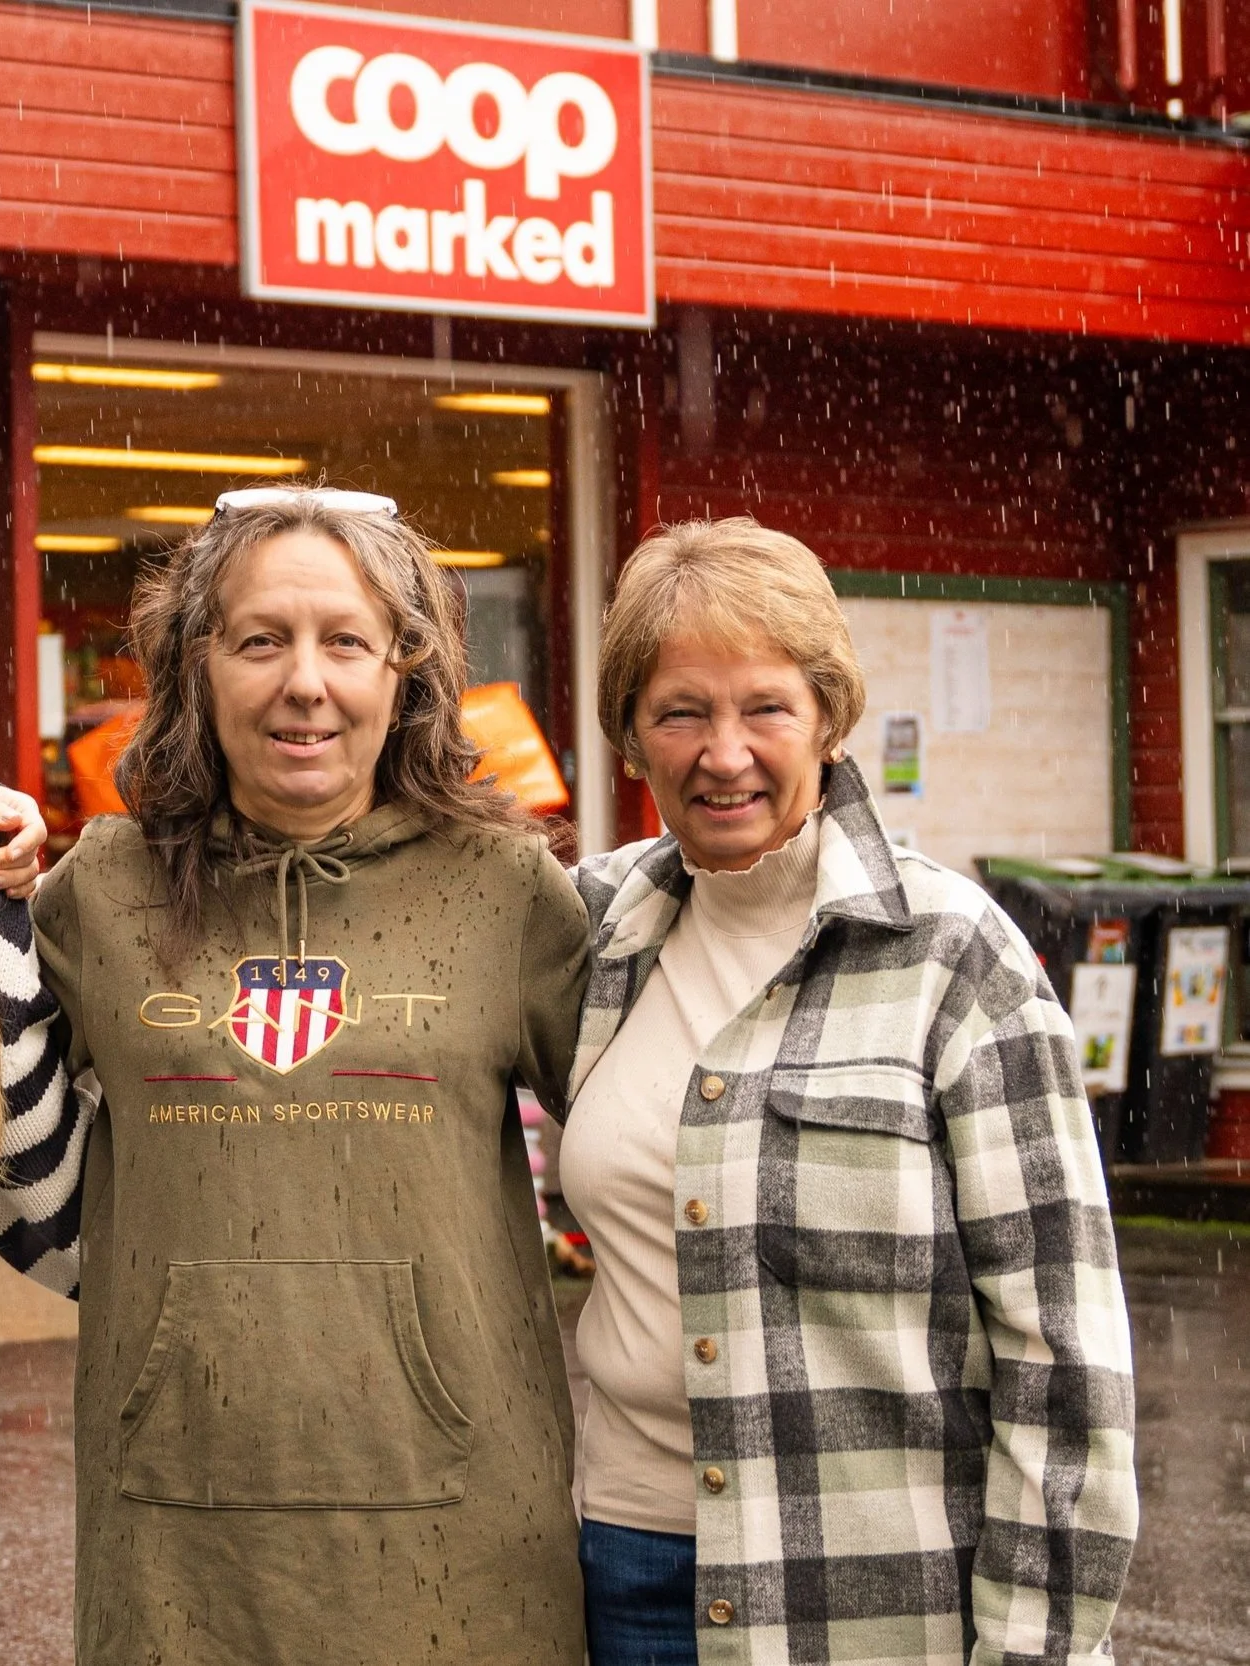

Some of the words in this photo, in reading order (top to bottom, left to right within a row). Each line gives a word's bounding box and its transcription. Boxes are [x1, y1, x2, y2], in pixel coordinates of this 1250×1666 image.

[290, 44, 618, 200] coop
[295, 178, 615, 288] marked
[139, 992, 447, 1033] GANT
[149, 1103, 261, 1123] AMERICAN
[273, 1100, 435, 1124] SPORTSWEAR
